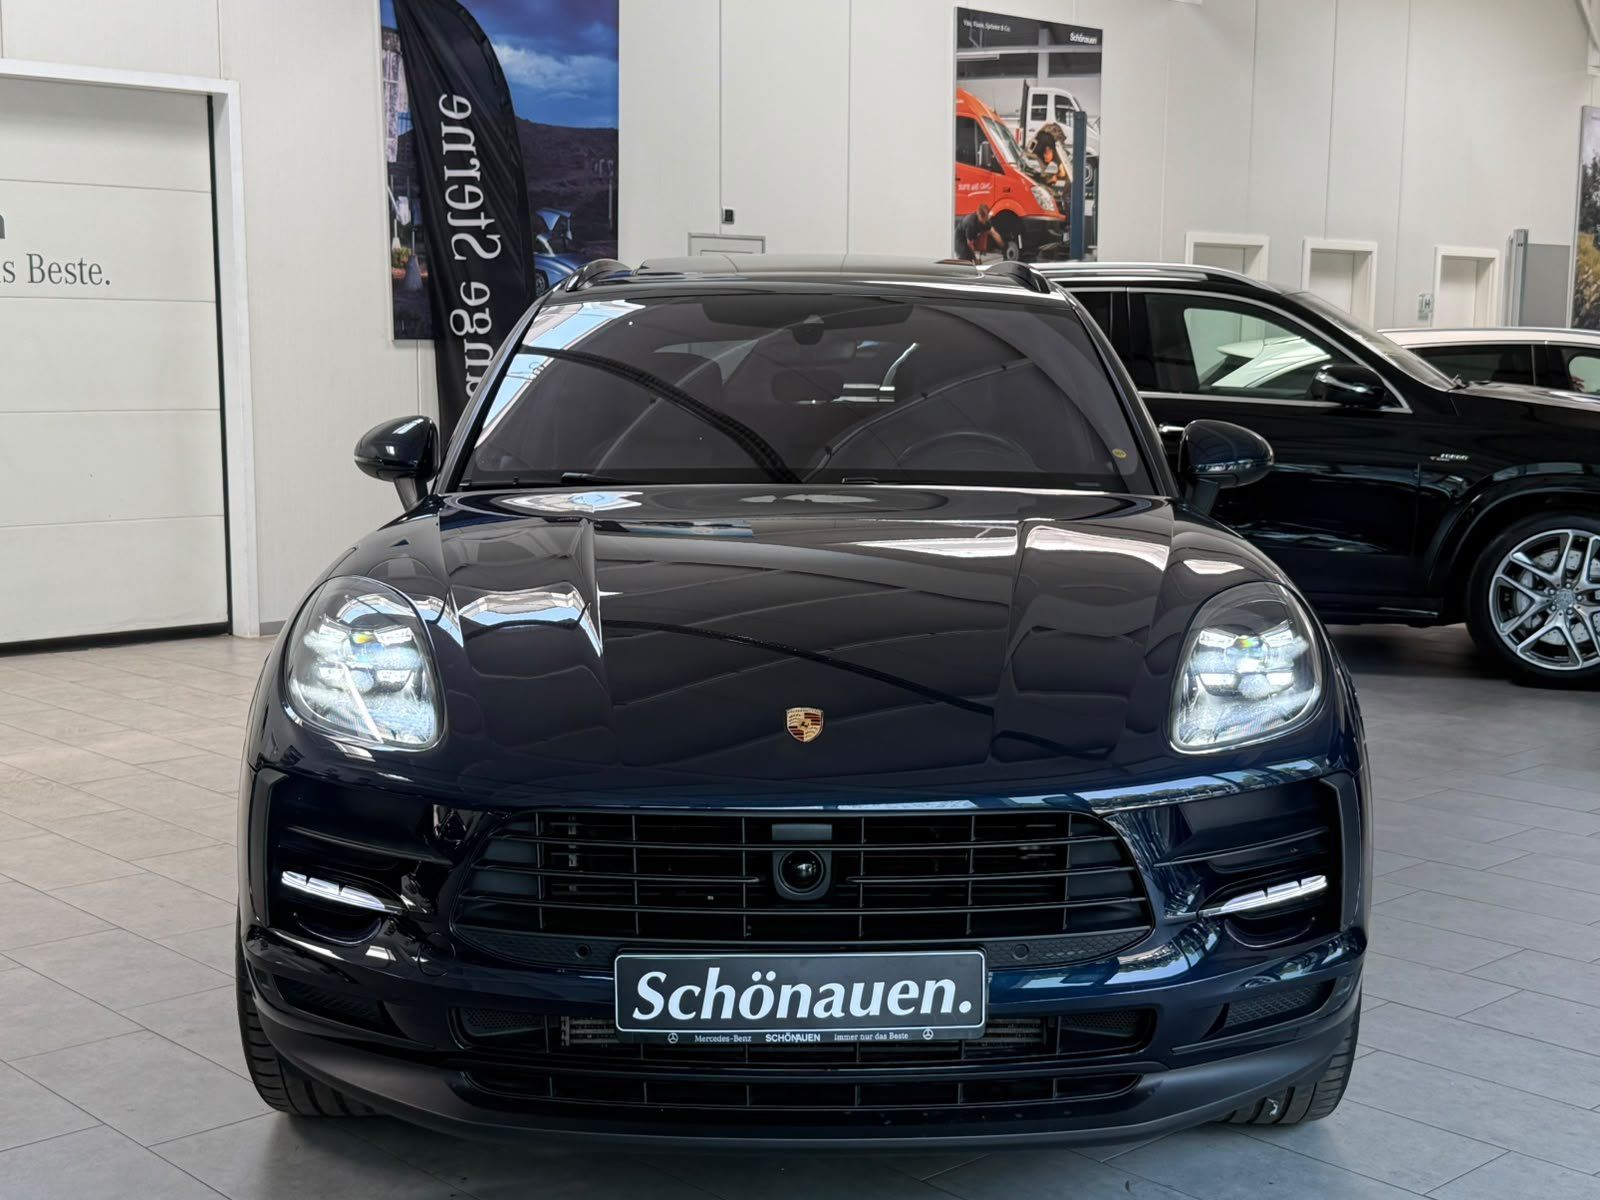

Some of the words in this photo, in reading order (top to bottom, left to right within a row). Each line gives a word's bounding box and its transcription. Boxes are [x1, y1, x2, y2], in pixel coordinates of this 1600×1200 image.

[26, 253, 111, 286] Beste.
[632, 967, 972, 1020] Schönauen.
[694, 1034, 752, 1043] Mercedes-Benz
[765, 1032, 821, 1042] SCHÖNAUEN
[875, 1032, 887, 1040] das
[889, 1032, 909, 1040] Beste
